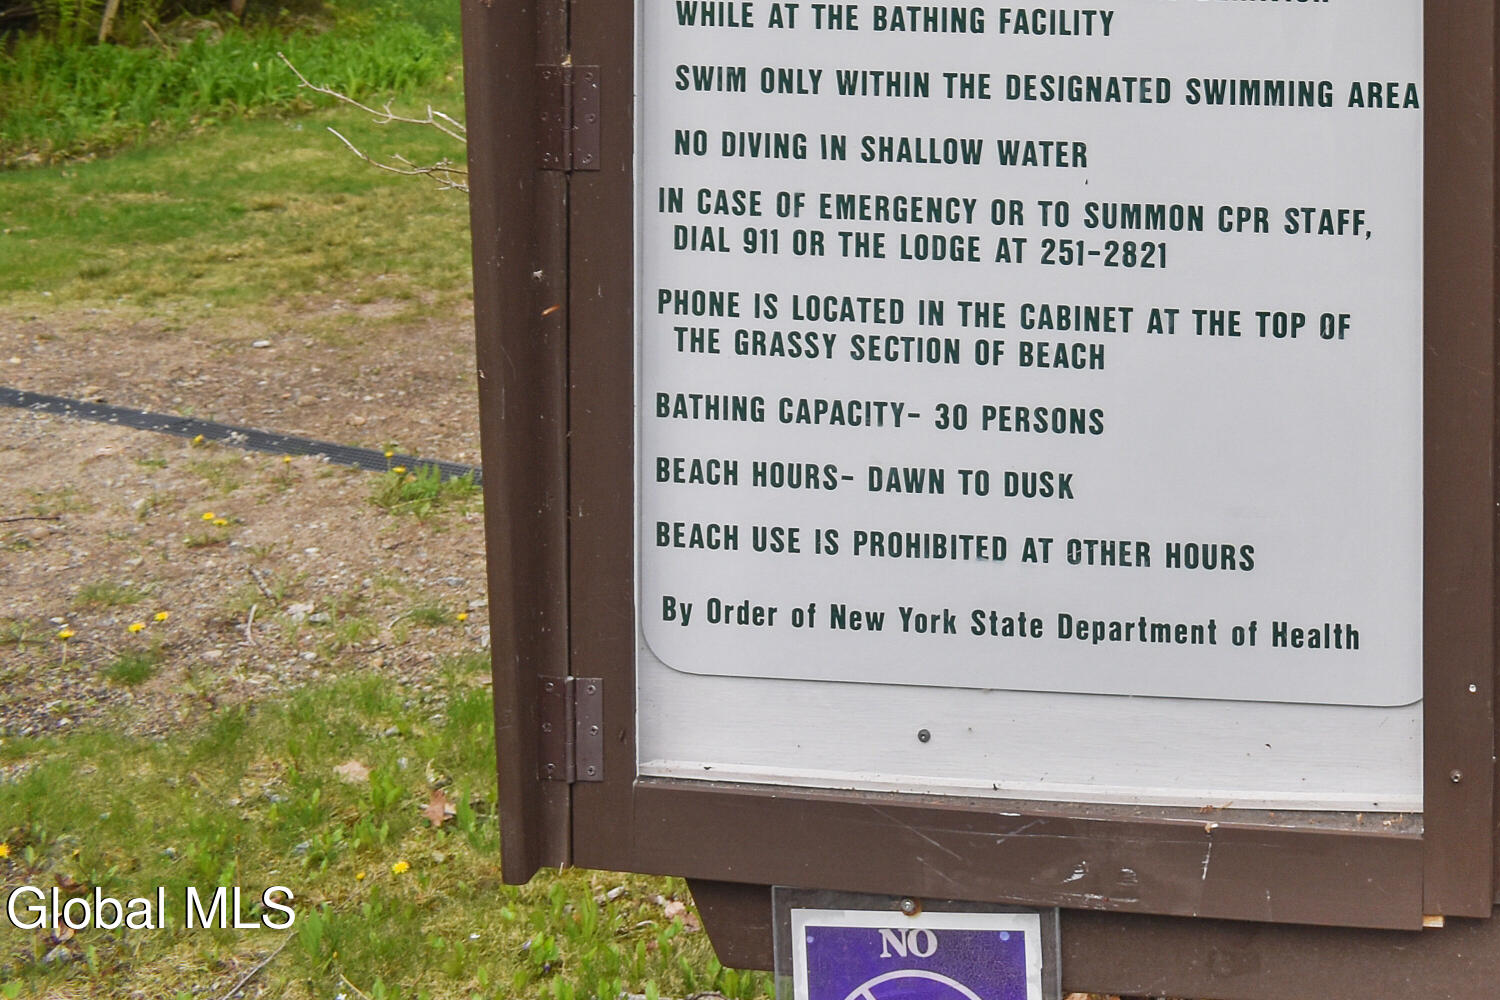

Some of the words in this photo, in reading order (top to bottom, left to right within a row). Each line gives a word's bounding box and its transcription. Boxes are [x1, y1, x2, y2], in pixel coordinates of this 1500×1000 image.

[676, 65, 746, 92] SWIM
[761, 67, 822, 94] ONLY
[836, 70, 929, 97] WITHIN
[943, 73, 990, 99] THE
[1006, 75, 1170, 103] DESIGNATED
[1186, 78, 1332, 107] SWIMMING
[1348, 82, 1419, 109] AREA
[657, 393, 764, 422] BATHING
[935, 404, 967, 430] 30
[983, 405, 1103, 435] PERSONS
[663, 596, 692, 626] By
[707, 598, 777, 626] Order
[792, 603, 815, 628] of
[831, 604, 884, 631] New
[899, 607, 956, 634] York
[971, 610, 1042, 638] State
[1058, 614, 1216, 644] Department
[1232, 621, 1257, 646] of
[1273, 622, 1359, 649] Health
[878, 928, 938, 958] NO
